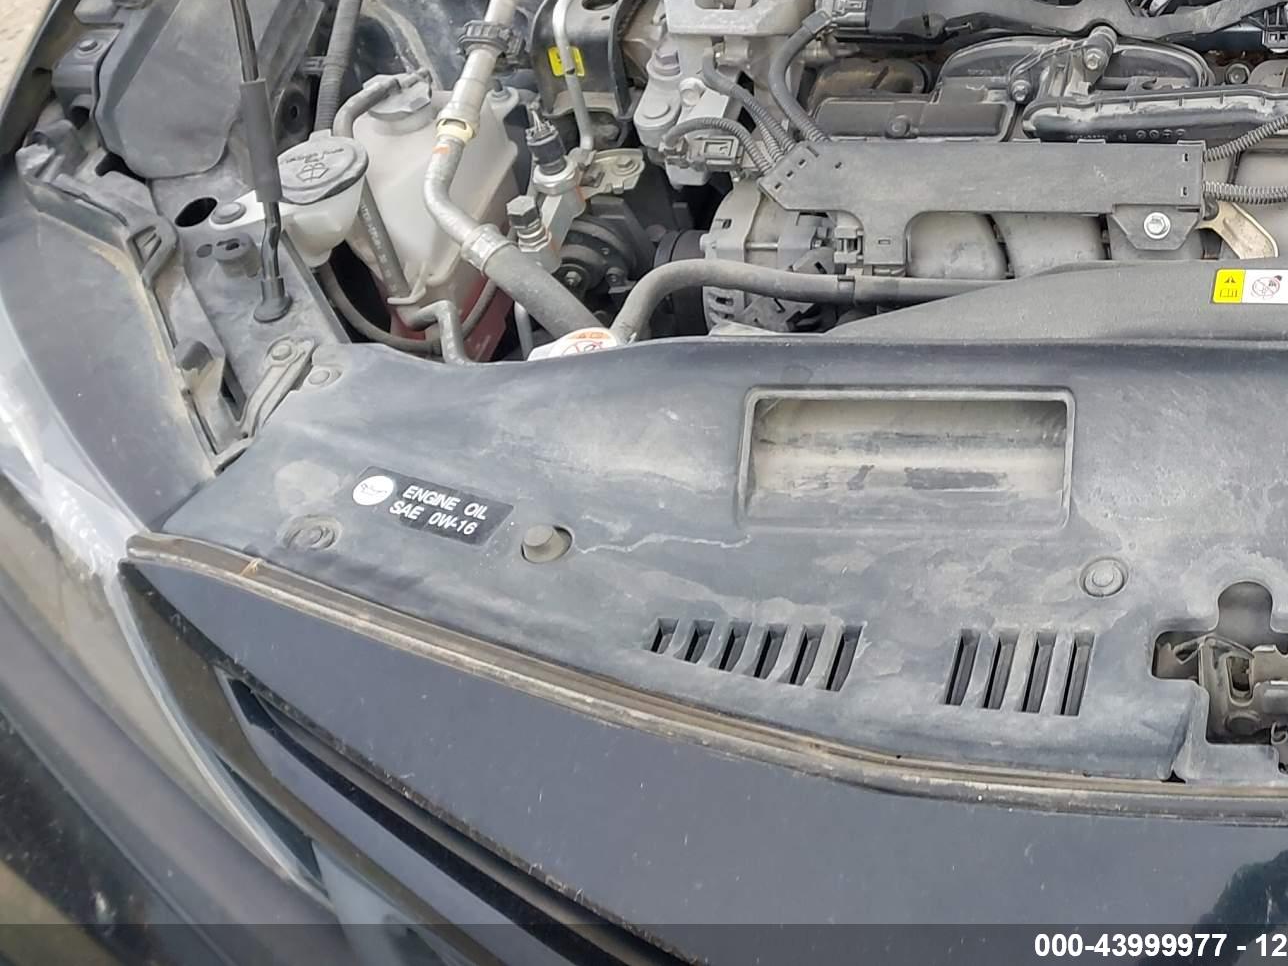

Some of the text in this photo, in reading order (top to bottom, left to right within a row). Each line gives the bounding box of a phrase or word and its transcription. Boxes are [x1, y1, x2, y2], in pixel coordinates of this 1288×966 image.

[389, 501, 478, 535] SAE 0W-16
[402, 485, 489, 520] ENGINE OIL
